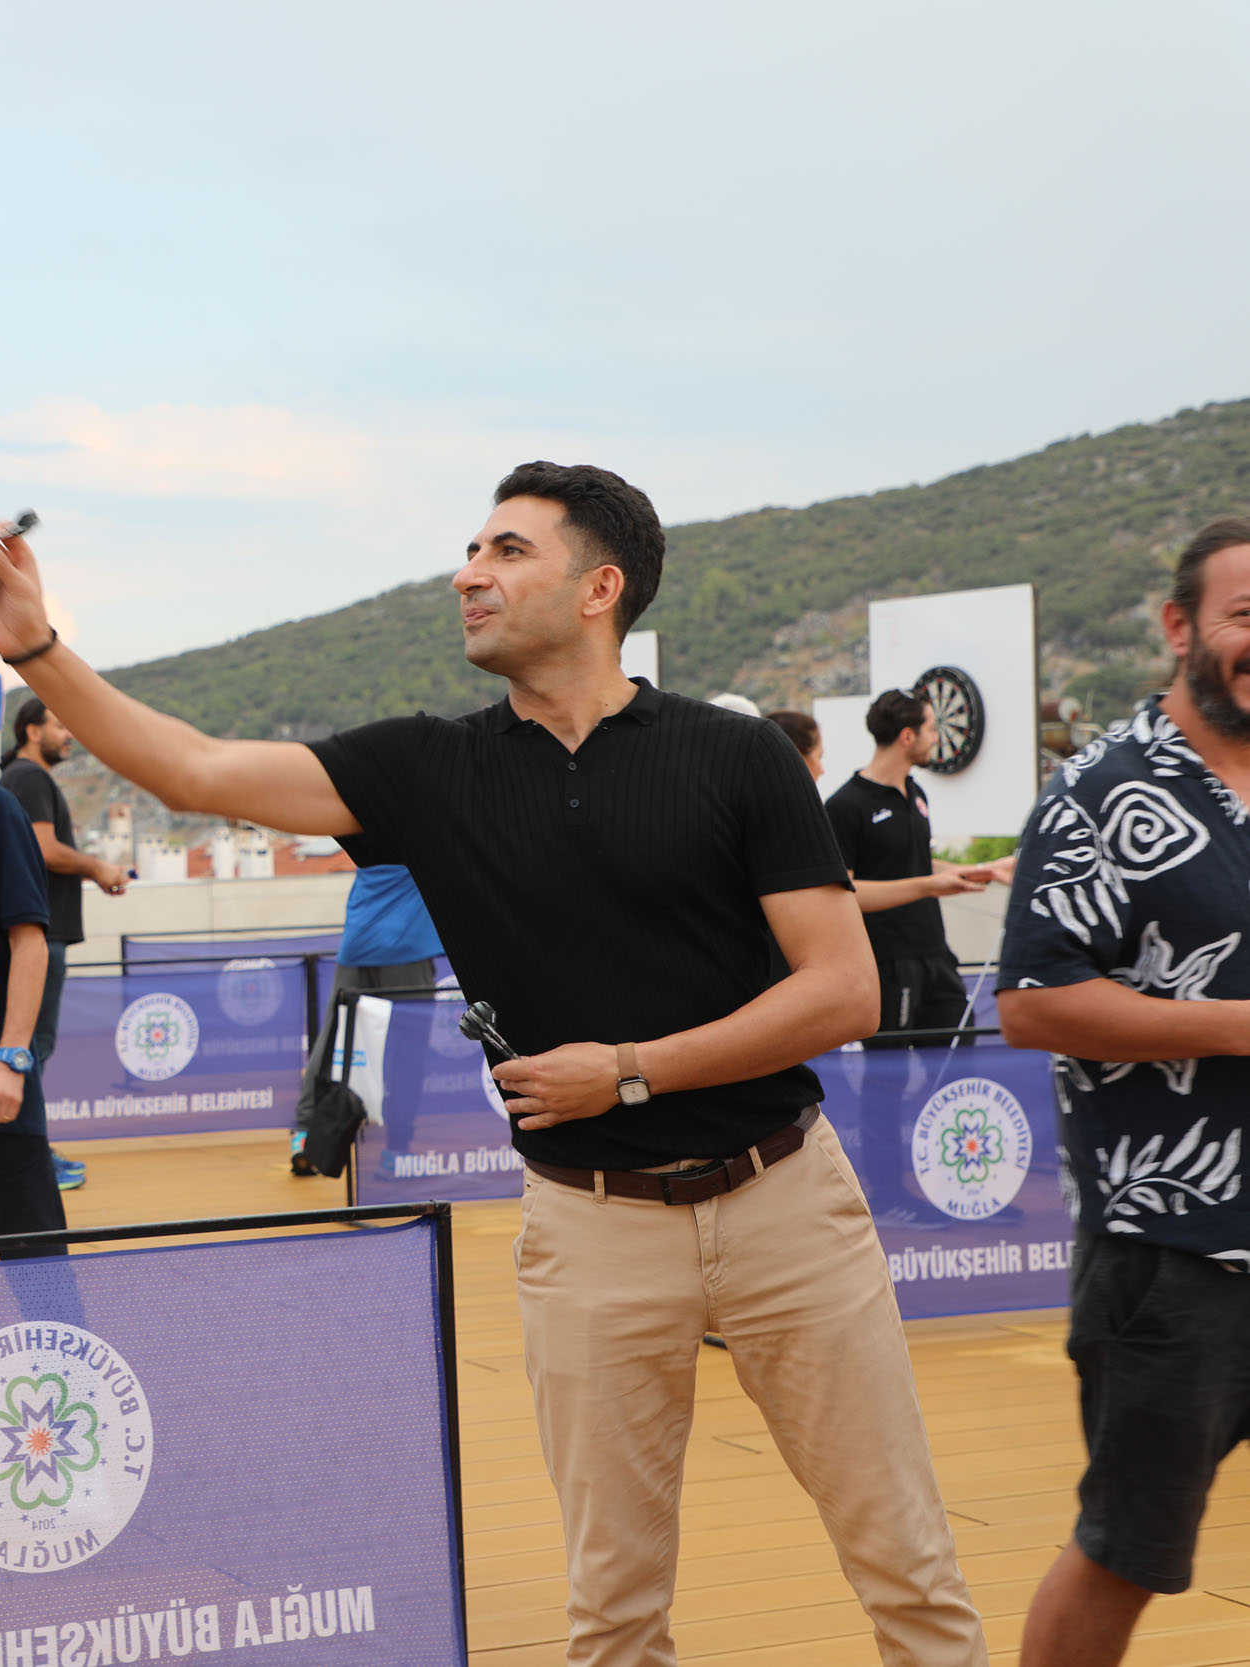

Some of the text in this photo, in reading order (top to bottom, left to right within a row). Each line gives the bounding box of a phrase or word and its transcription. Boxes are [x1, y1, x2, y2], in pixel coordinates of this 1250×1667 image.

[94, 1092, 188, 1117] BÜYÜKŞEHİR
[191, 1086, 274, 1112] BELEDİYESİ
[394, 1151, 460, 1177] MUĞLA
[947, 1197, 1000, 1216] MUĞLA
[888, 1240, 1022, 1282] BÜYÜKŞEHİR
